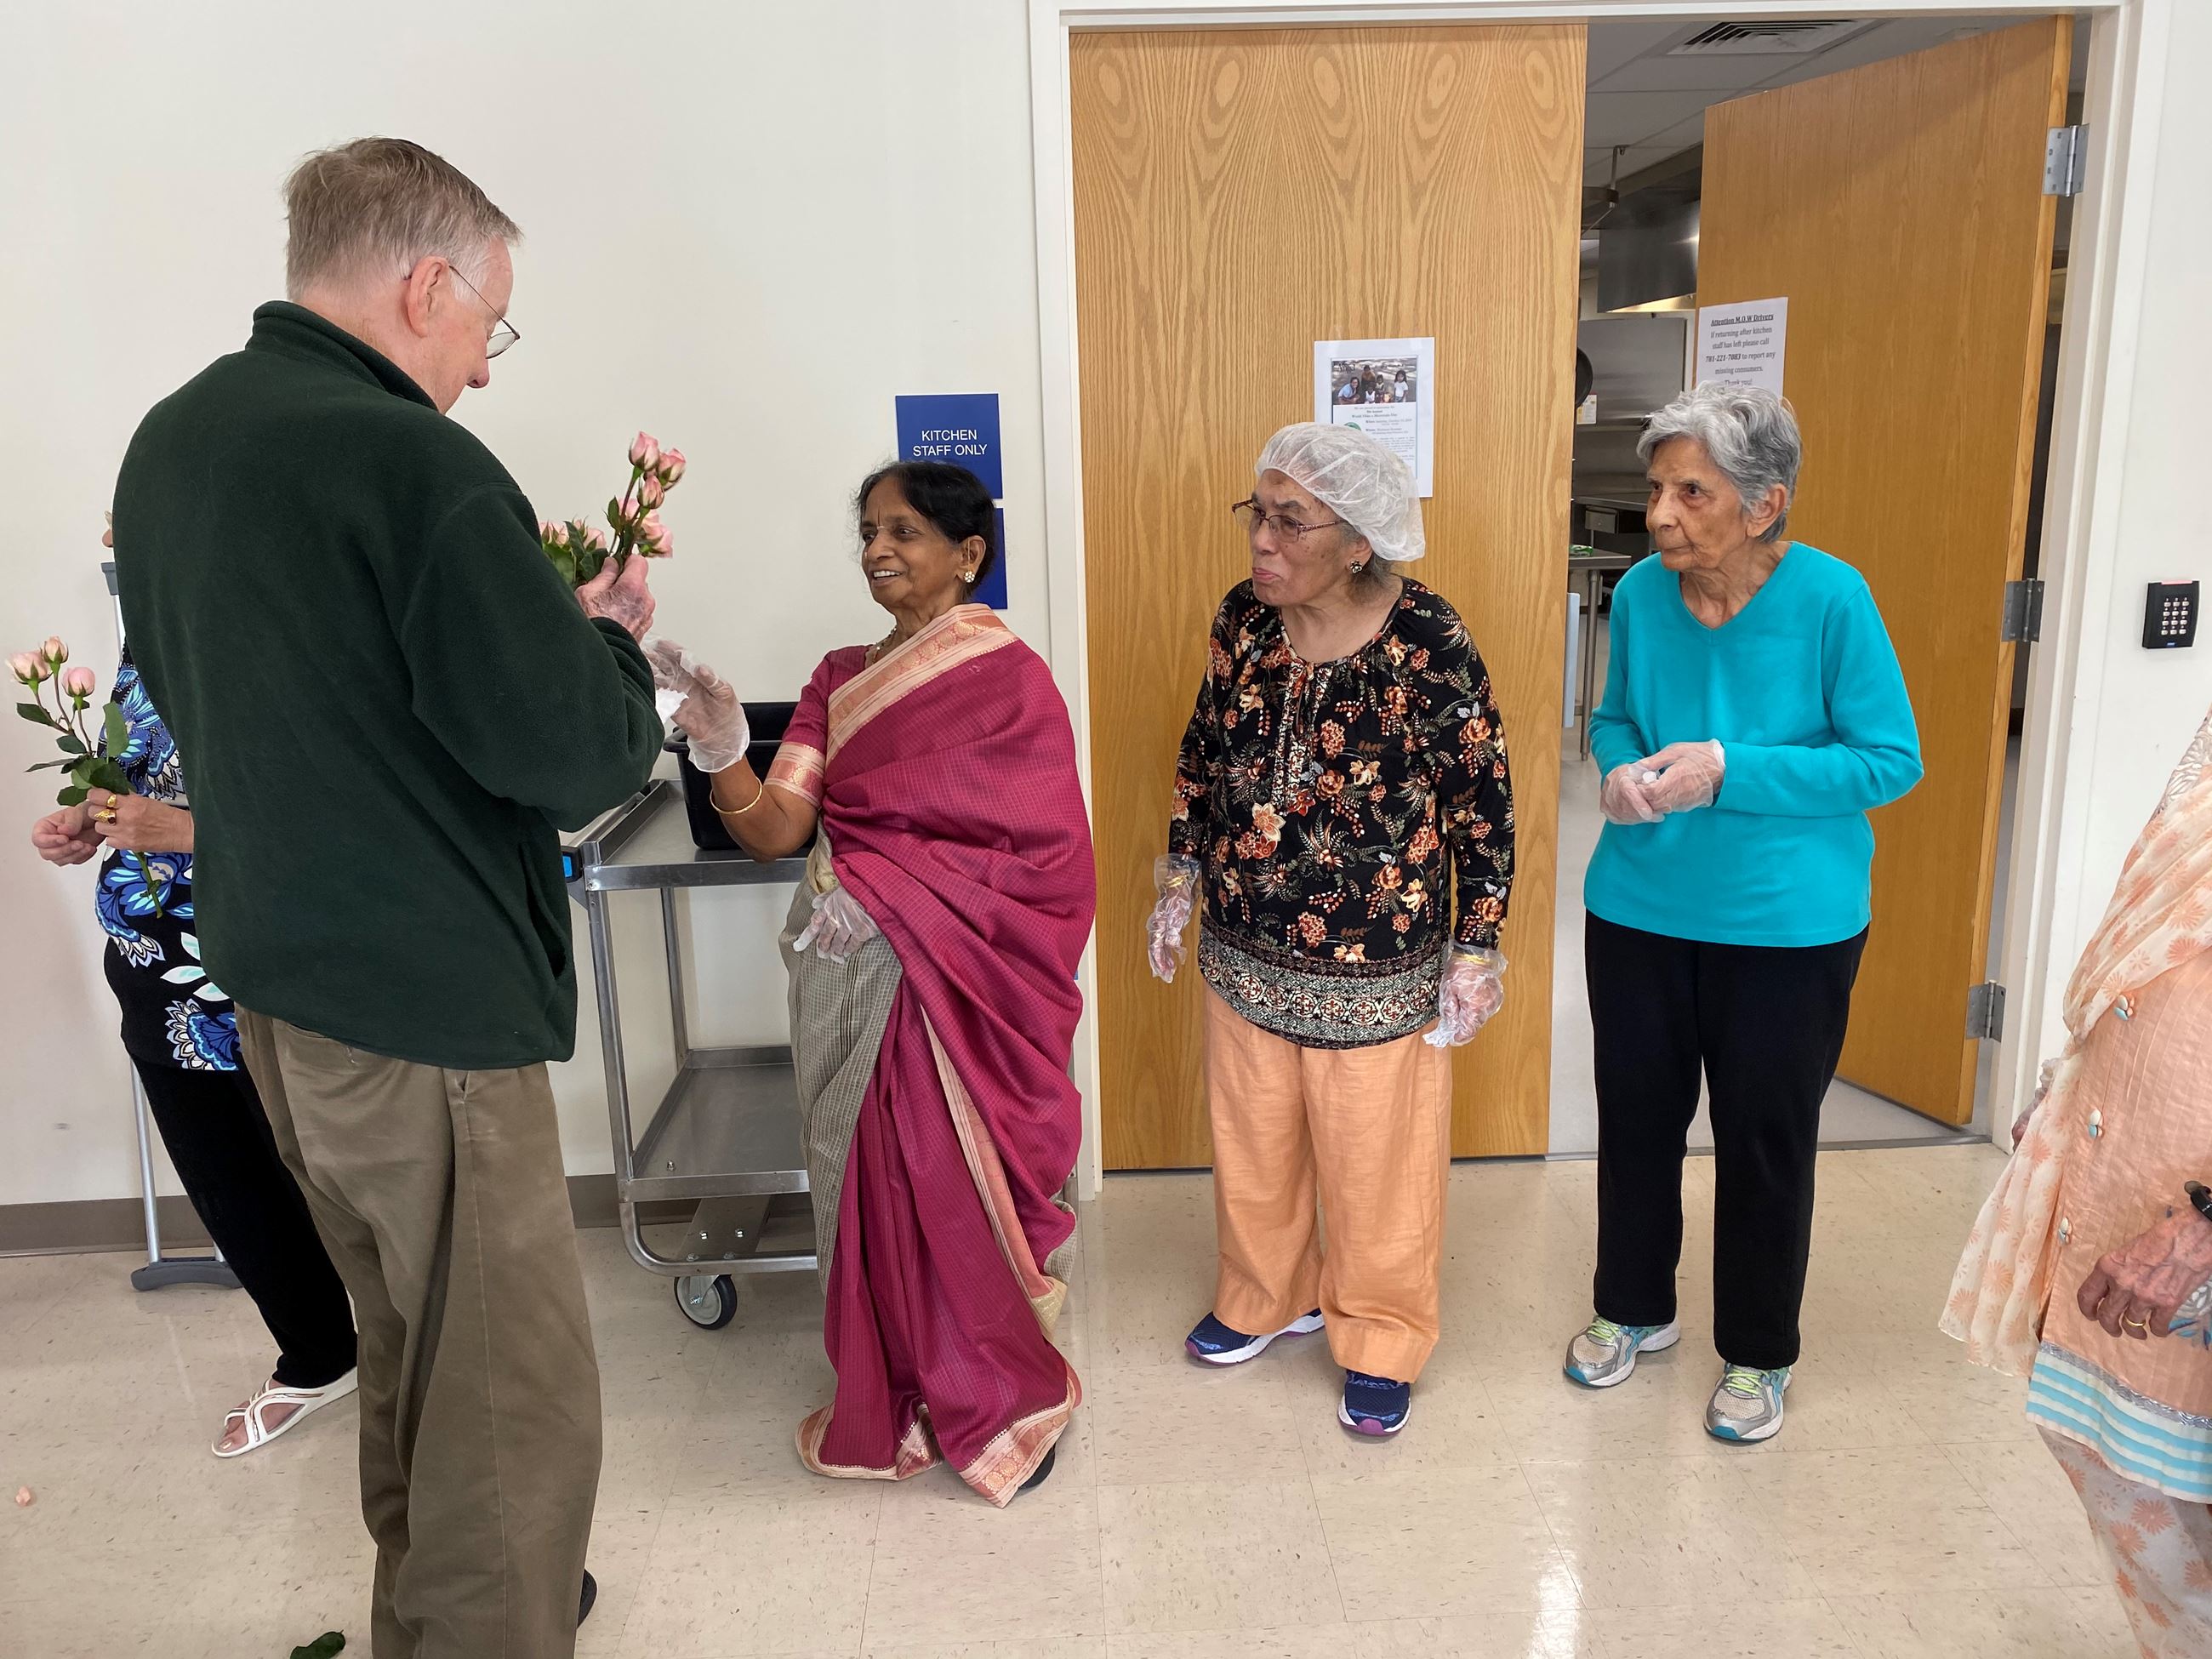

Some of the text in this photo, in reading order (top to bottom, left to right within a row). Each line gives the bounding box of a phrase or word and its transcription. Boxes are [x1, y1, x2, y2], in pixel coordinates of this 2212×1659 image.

[1711, 318, 1735, 327] Attention
[1742, 339, 1759, 348] please
[1747, 352, 1765, 361] report
[921, 429, 978, 442] KITCHEN
[913, 444, 988, 457] STAFF ONLY
